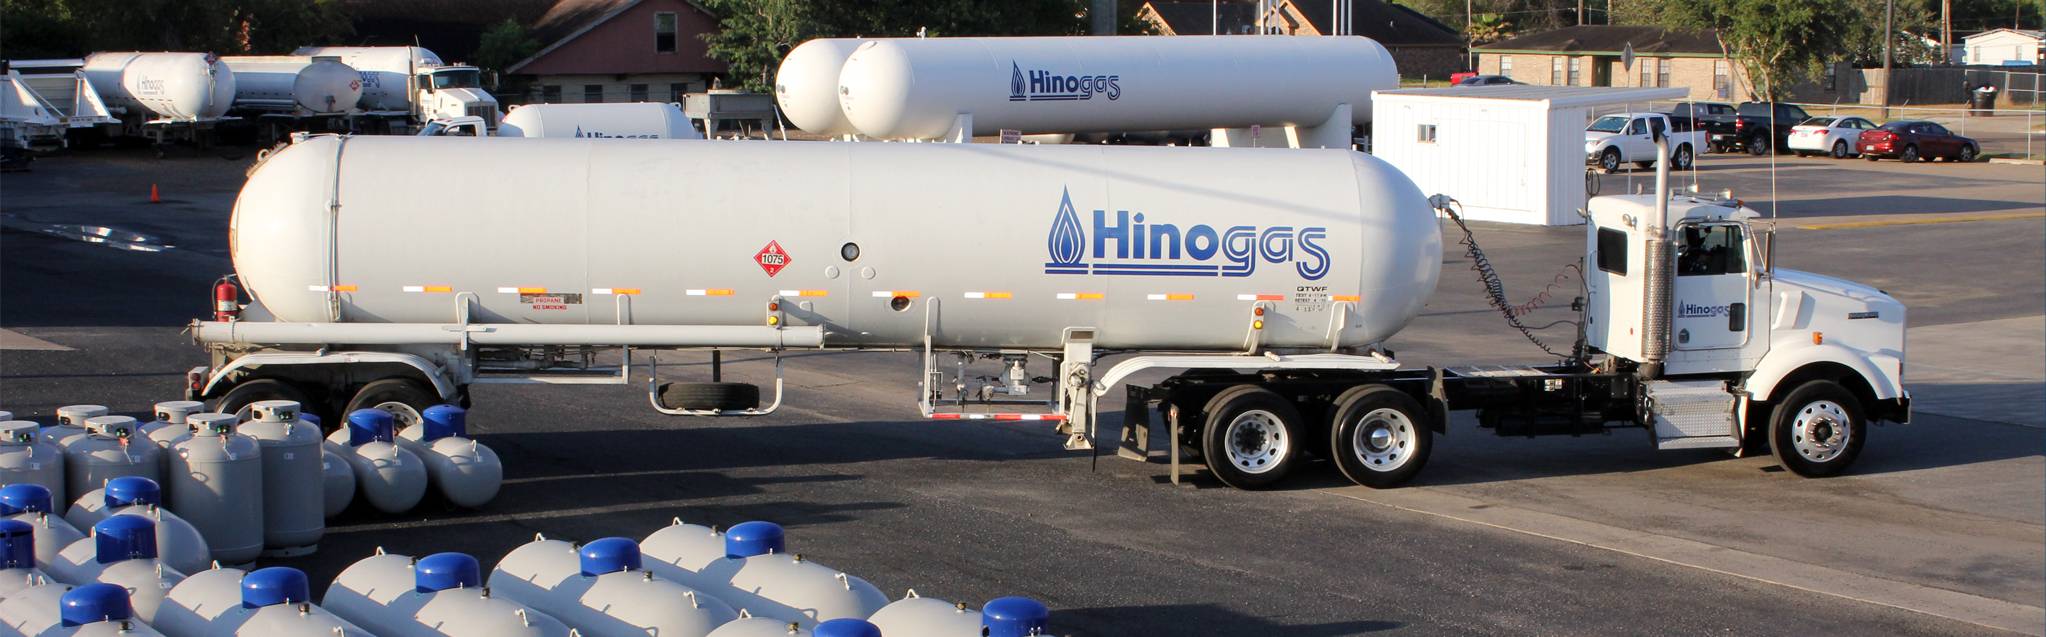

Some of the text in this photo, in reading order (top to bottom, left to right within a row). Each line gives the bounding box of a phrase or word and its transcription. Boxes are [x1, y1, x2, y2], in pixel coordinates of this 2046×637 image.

[1029, 70, 1120, 101] Hinogas
[763, 254, 784, 264] 1075
[1093, 209, 1331, 281] Hinogas
